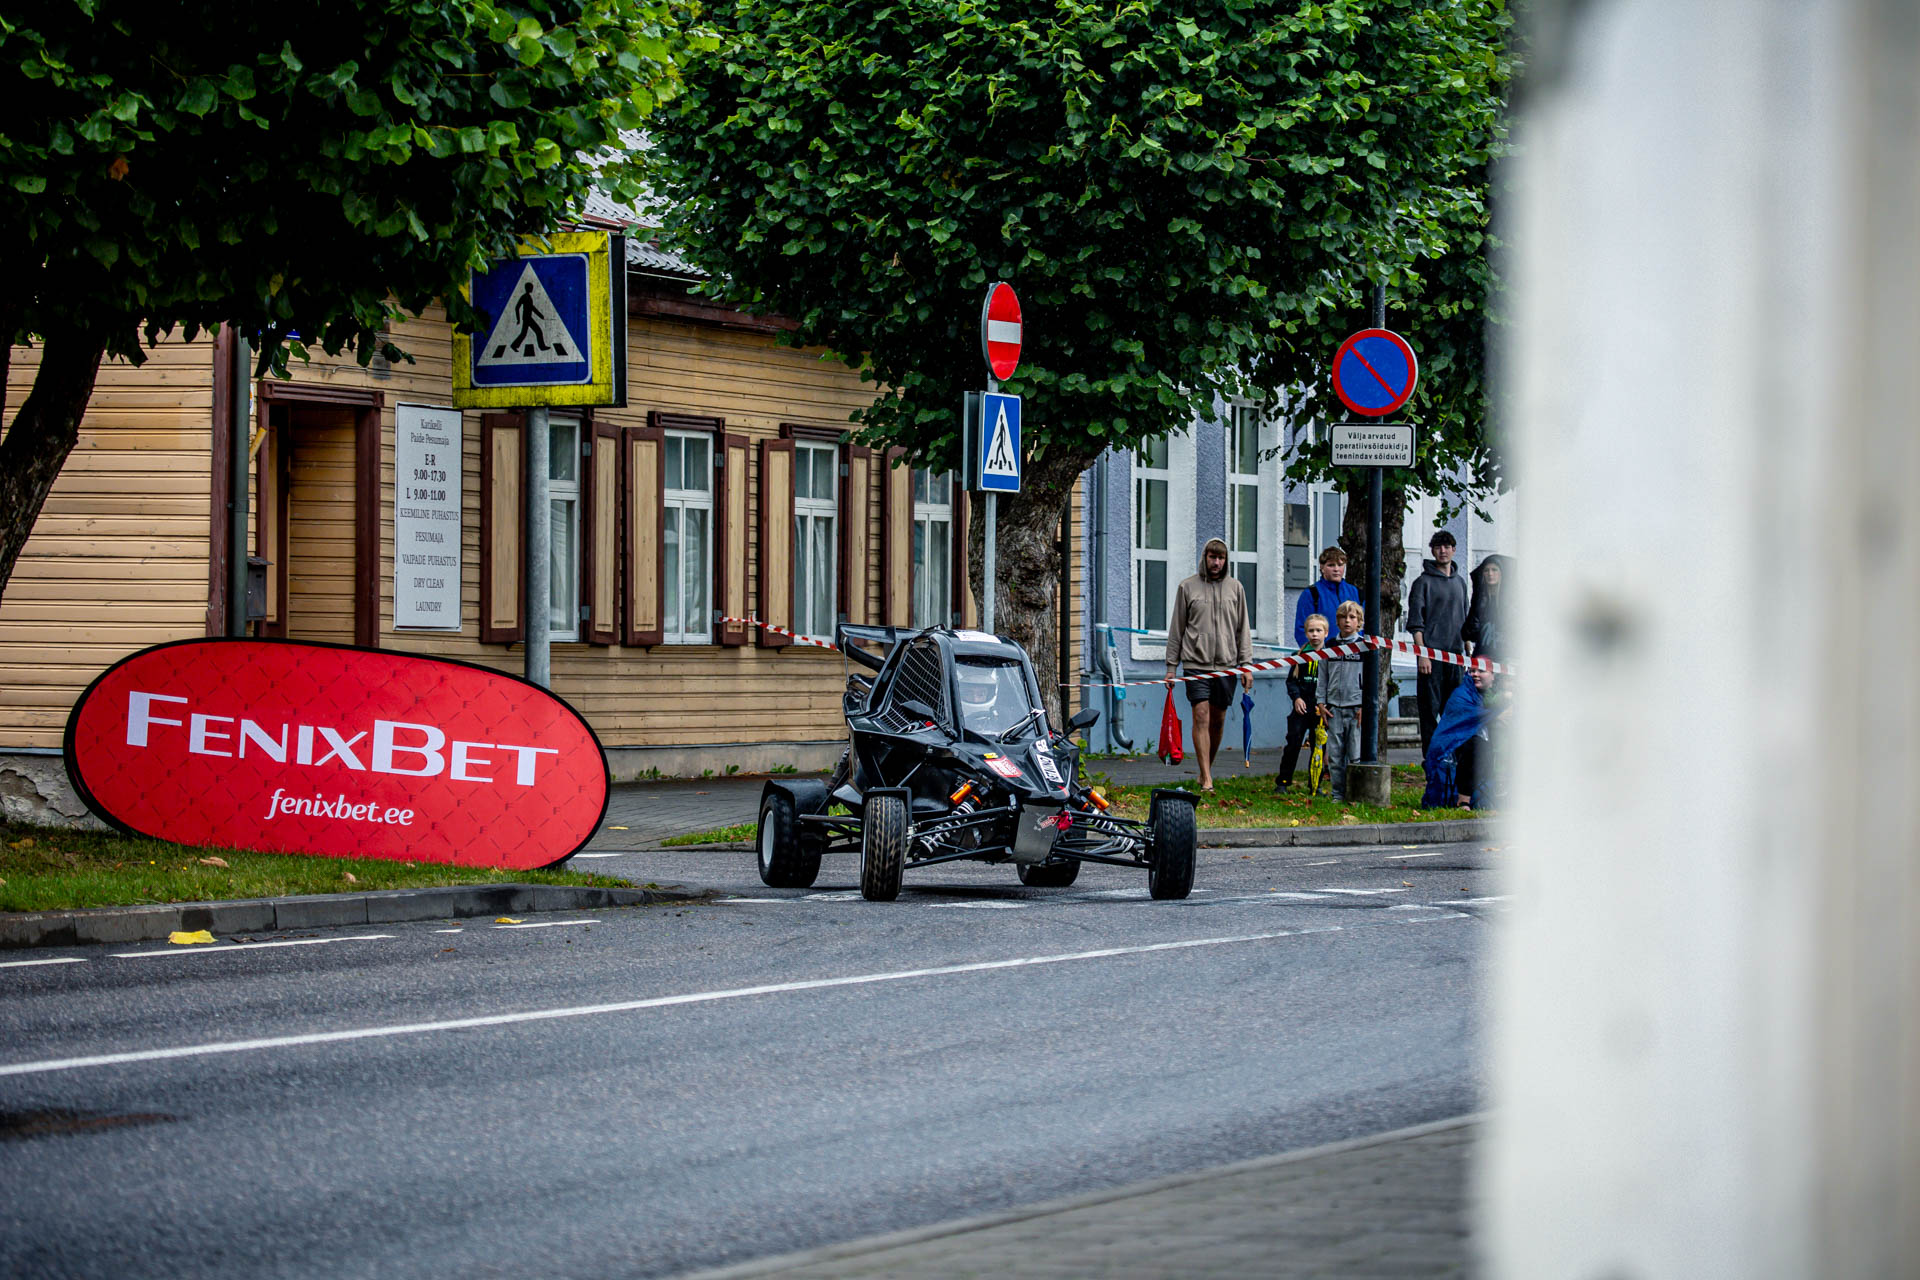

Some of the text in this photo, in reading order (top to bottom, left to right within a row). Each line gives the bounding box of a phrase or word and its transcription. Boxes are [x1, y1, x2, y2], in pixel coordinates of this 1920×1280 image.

[411, 432, 449, 447] Paide Pesumaja
[1348, 432, 1396, 440] Välja arvatud
[1334, 442, 1400, 451] operatiivsõidukid
[424, 454, 436, 465] E-R
[1336, 452, 1407, 460] teenindav sõidukid
[414, 469, 446, 482] 9.00-17.30
[406, 487, 446, 501] L 9.00-11.00
[400, 508, 459, 521] KEEMILINE PUHASTUS
[415, 532, 444, 543] PESUMAJA
[402, 554, 457, 566] VAIPADE PUHASTUS
[413, 577, 444, 589] DRY CLEAN
[415, 601, 442, 612] LAUNDRY
[264, 788, 414, 825] fenixbet.ee
